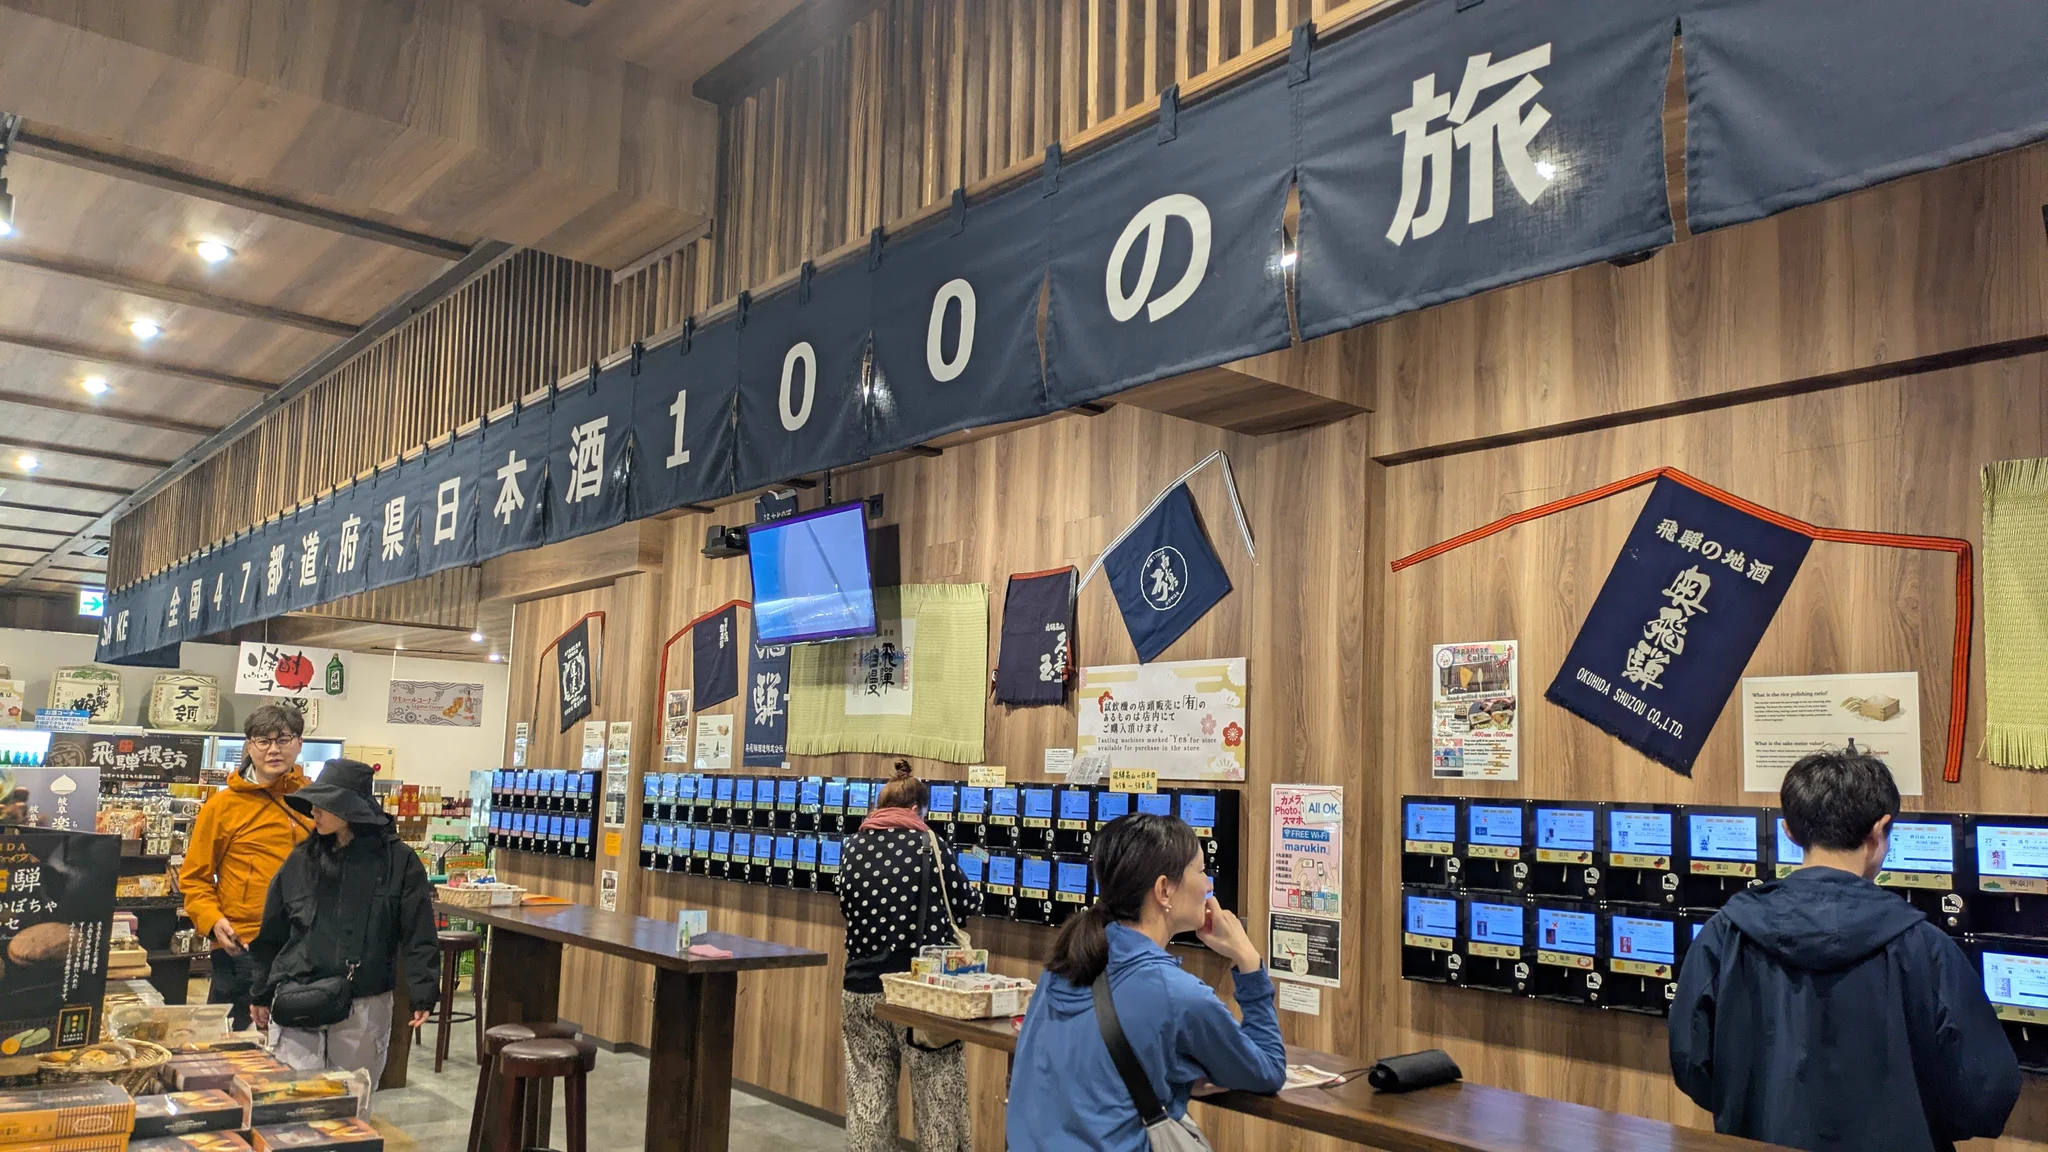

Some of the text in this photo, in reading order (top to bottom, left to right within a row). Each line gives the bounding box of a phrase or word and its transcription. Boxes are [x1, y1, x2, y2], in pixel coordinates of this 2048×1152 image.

[1655, 518, 1774, 585] 飛騨の地酒
[1621, 564, 1712, 691] 奥飛騨
[1467, 653, 1498, 662] Culture
[243, 671, 269, 679] いろいろ
[258, 680, 324, 695] コーナー
[1576, 667, 1610, 696] OKUHIDA
[1612, 688, 1648, 716] SHUZOU
[1790, 690, 1813, 698] polishing
[173, 685, 200, 723] 天領
[1103, 711, 1176, 722] あるものは店内にて
[1102, 723, 1164, 734] ご購入頂けます。
[1098, 737, 1119, 745] Tasting
[1121, 736, 1145, 744] machines
[1190, 736, 1200, 744] for
[1135, 745, 1160, 753] purchase
[90, 741, 188, 772] 飛騨探訪
[1308, 802, 1341, 815] All OK.
[1291, 829, 1328, 840] FREE Wi-Fi
[1904, 874, 1920, 882] 新潟
[2009, 879, 2034, 887] 神奈川
